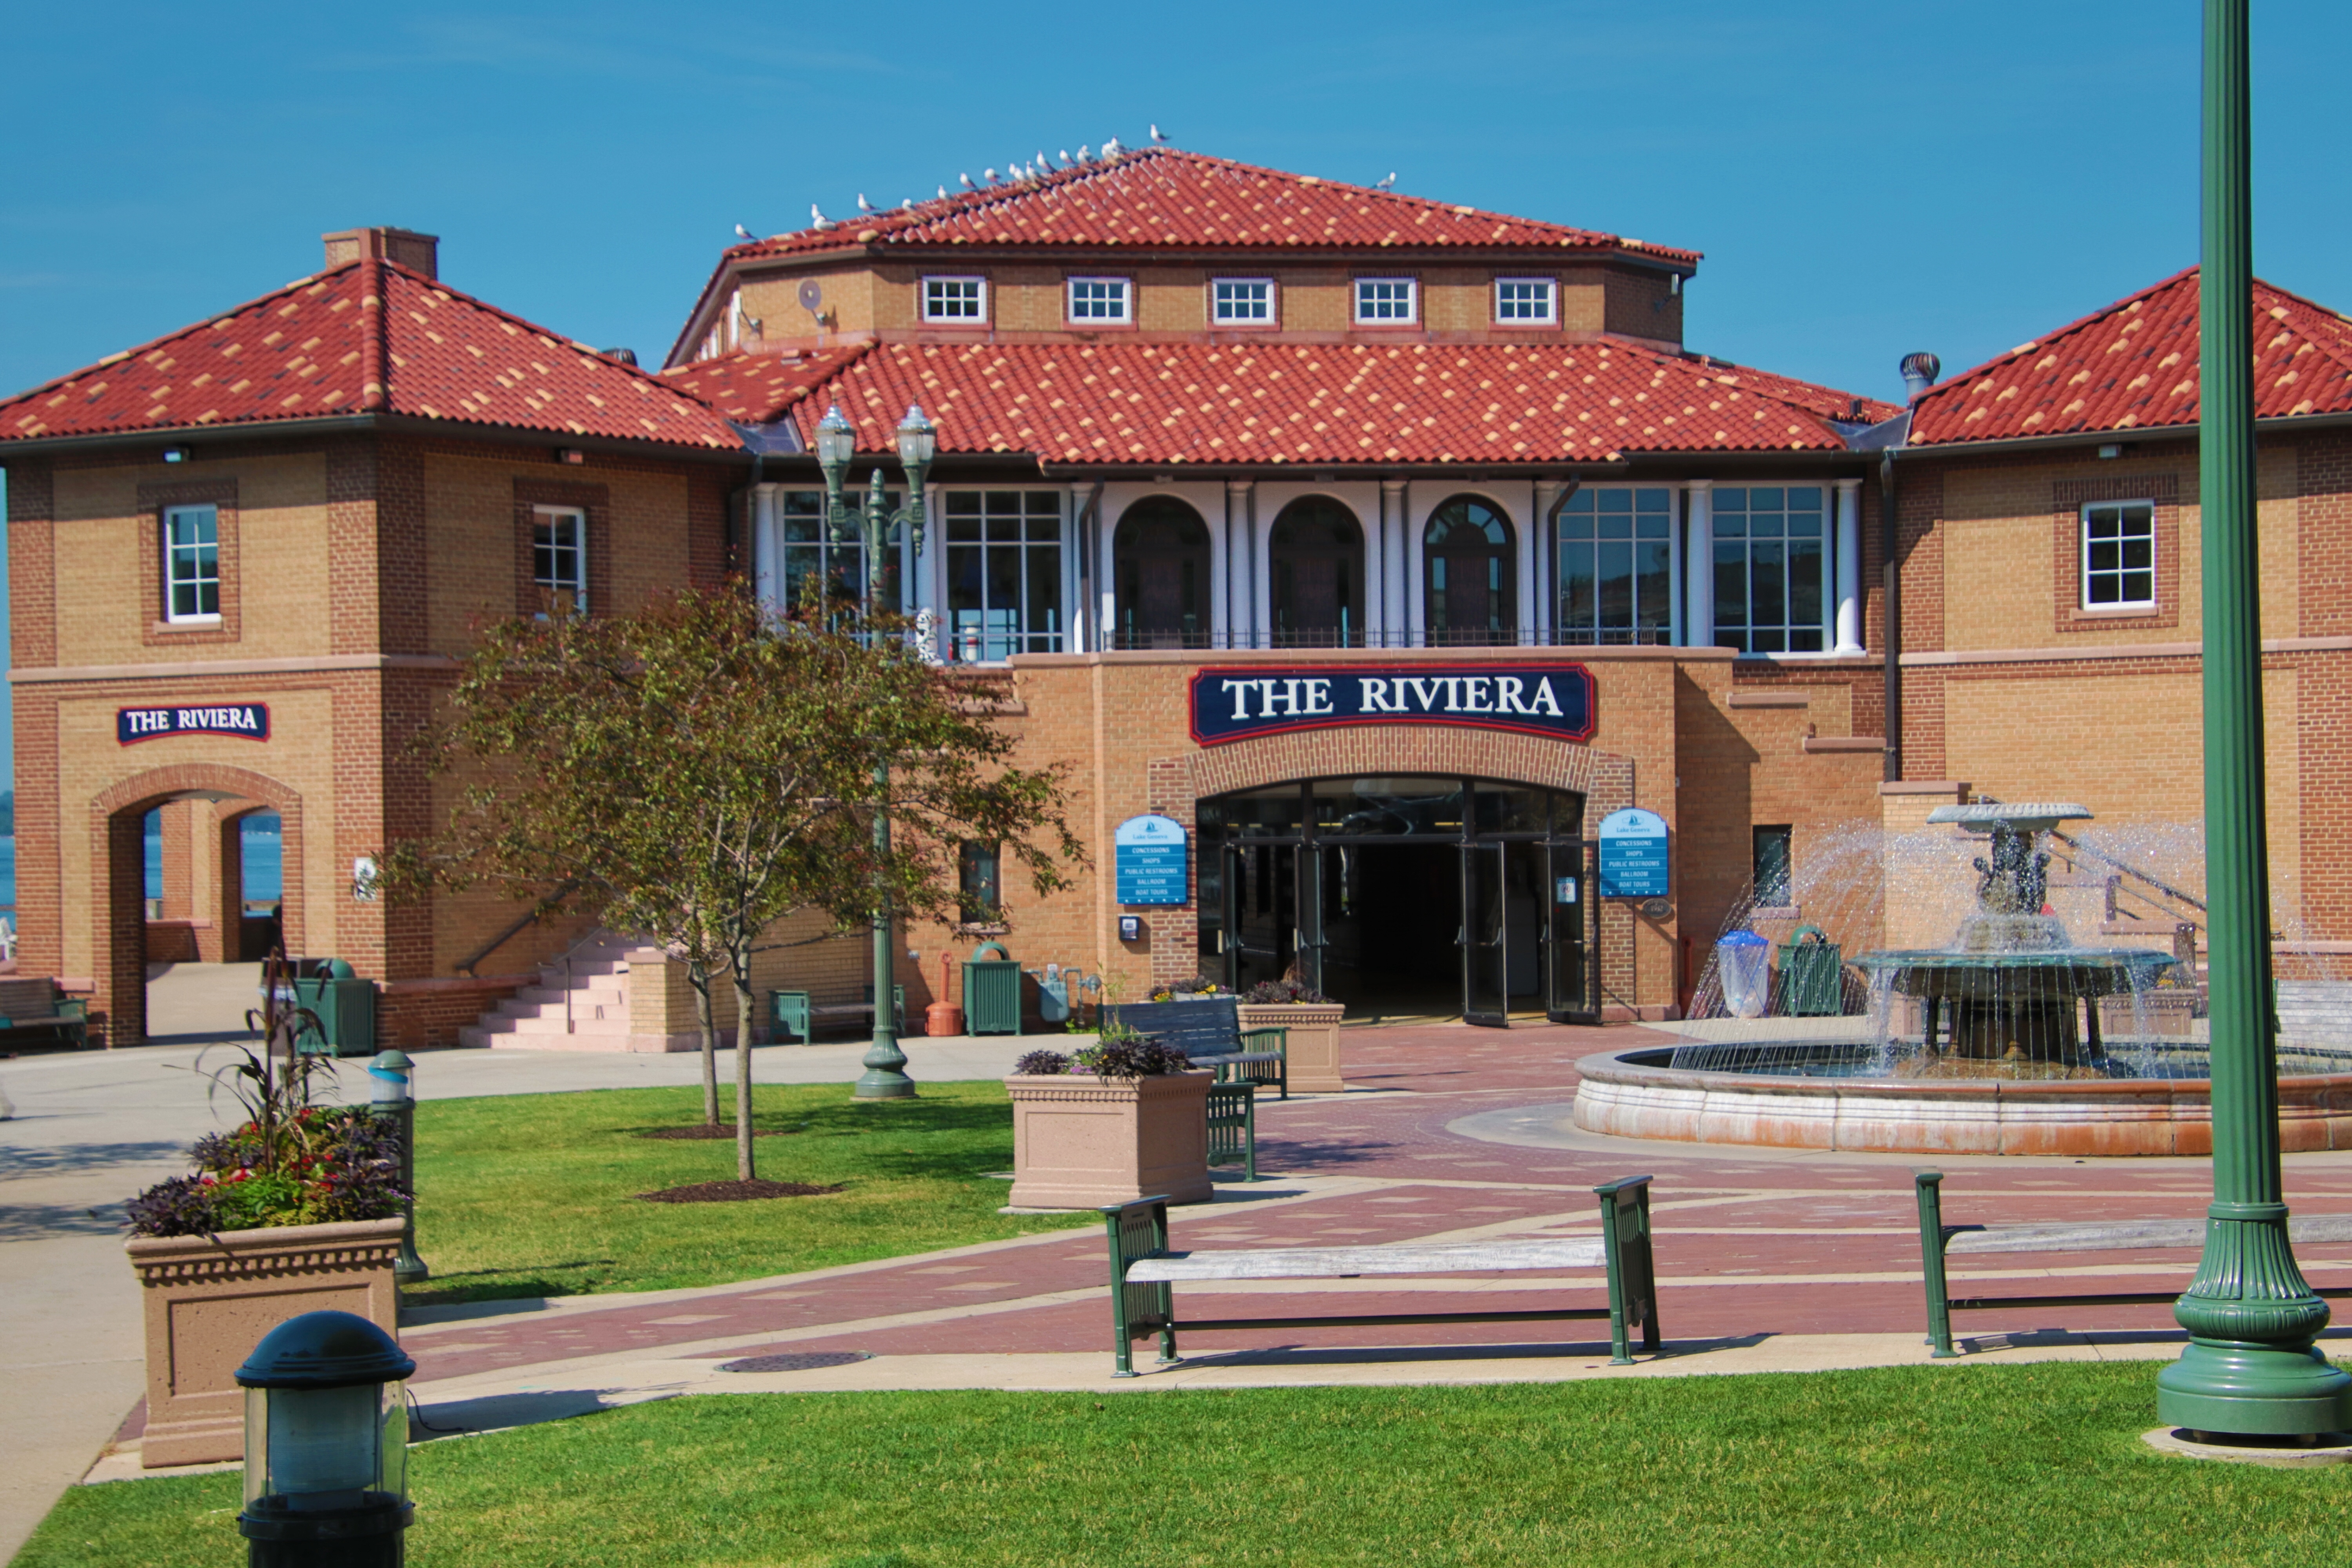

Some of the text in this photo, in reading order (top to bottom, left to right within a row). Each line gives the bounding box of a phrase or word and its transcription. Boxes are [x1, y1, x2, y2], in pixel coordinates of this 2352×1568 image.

[1221, 676, 1563, 720] THE RIVIERA
[126, 707, 258, 733] THE RIVIERA
